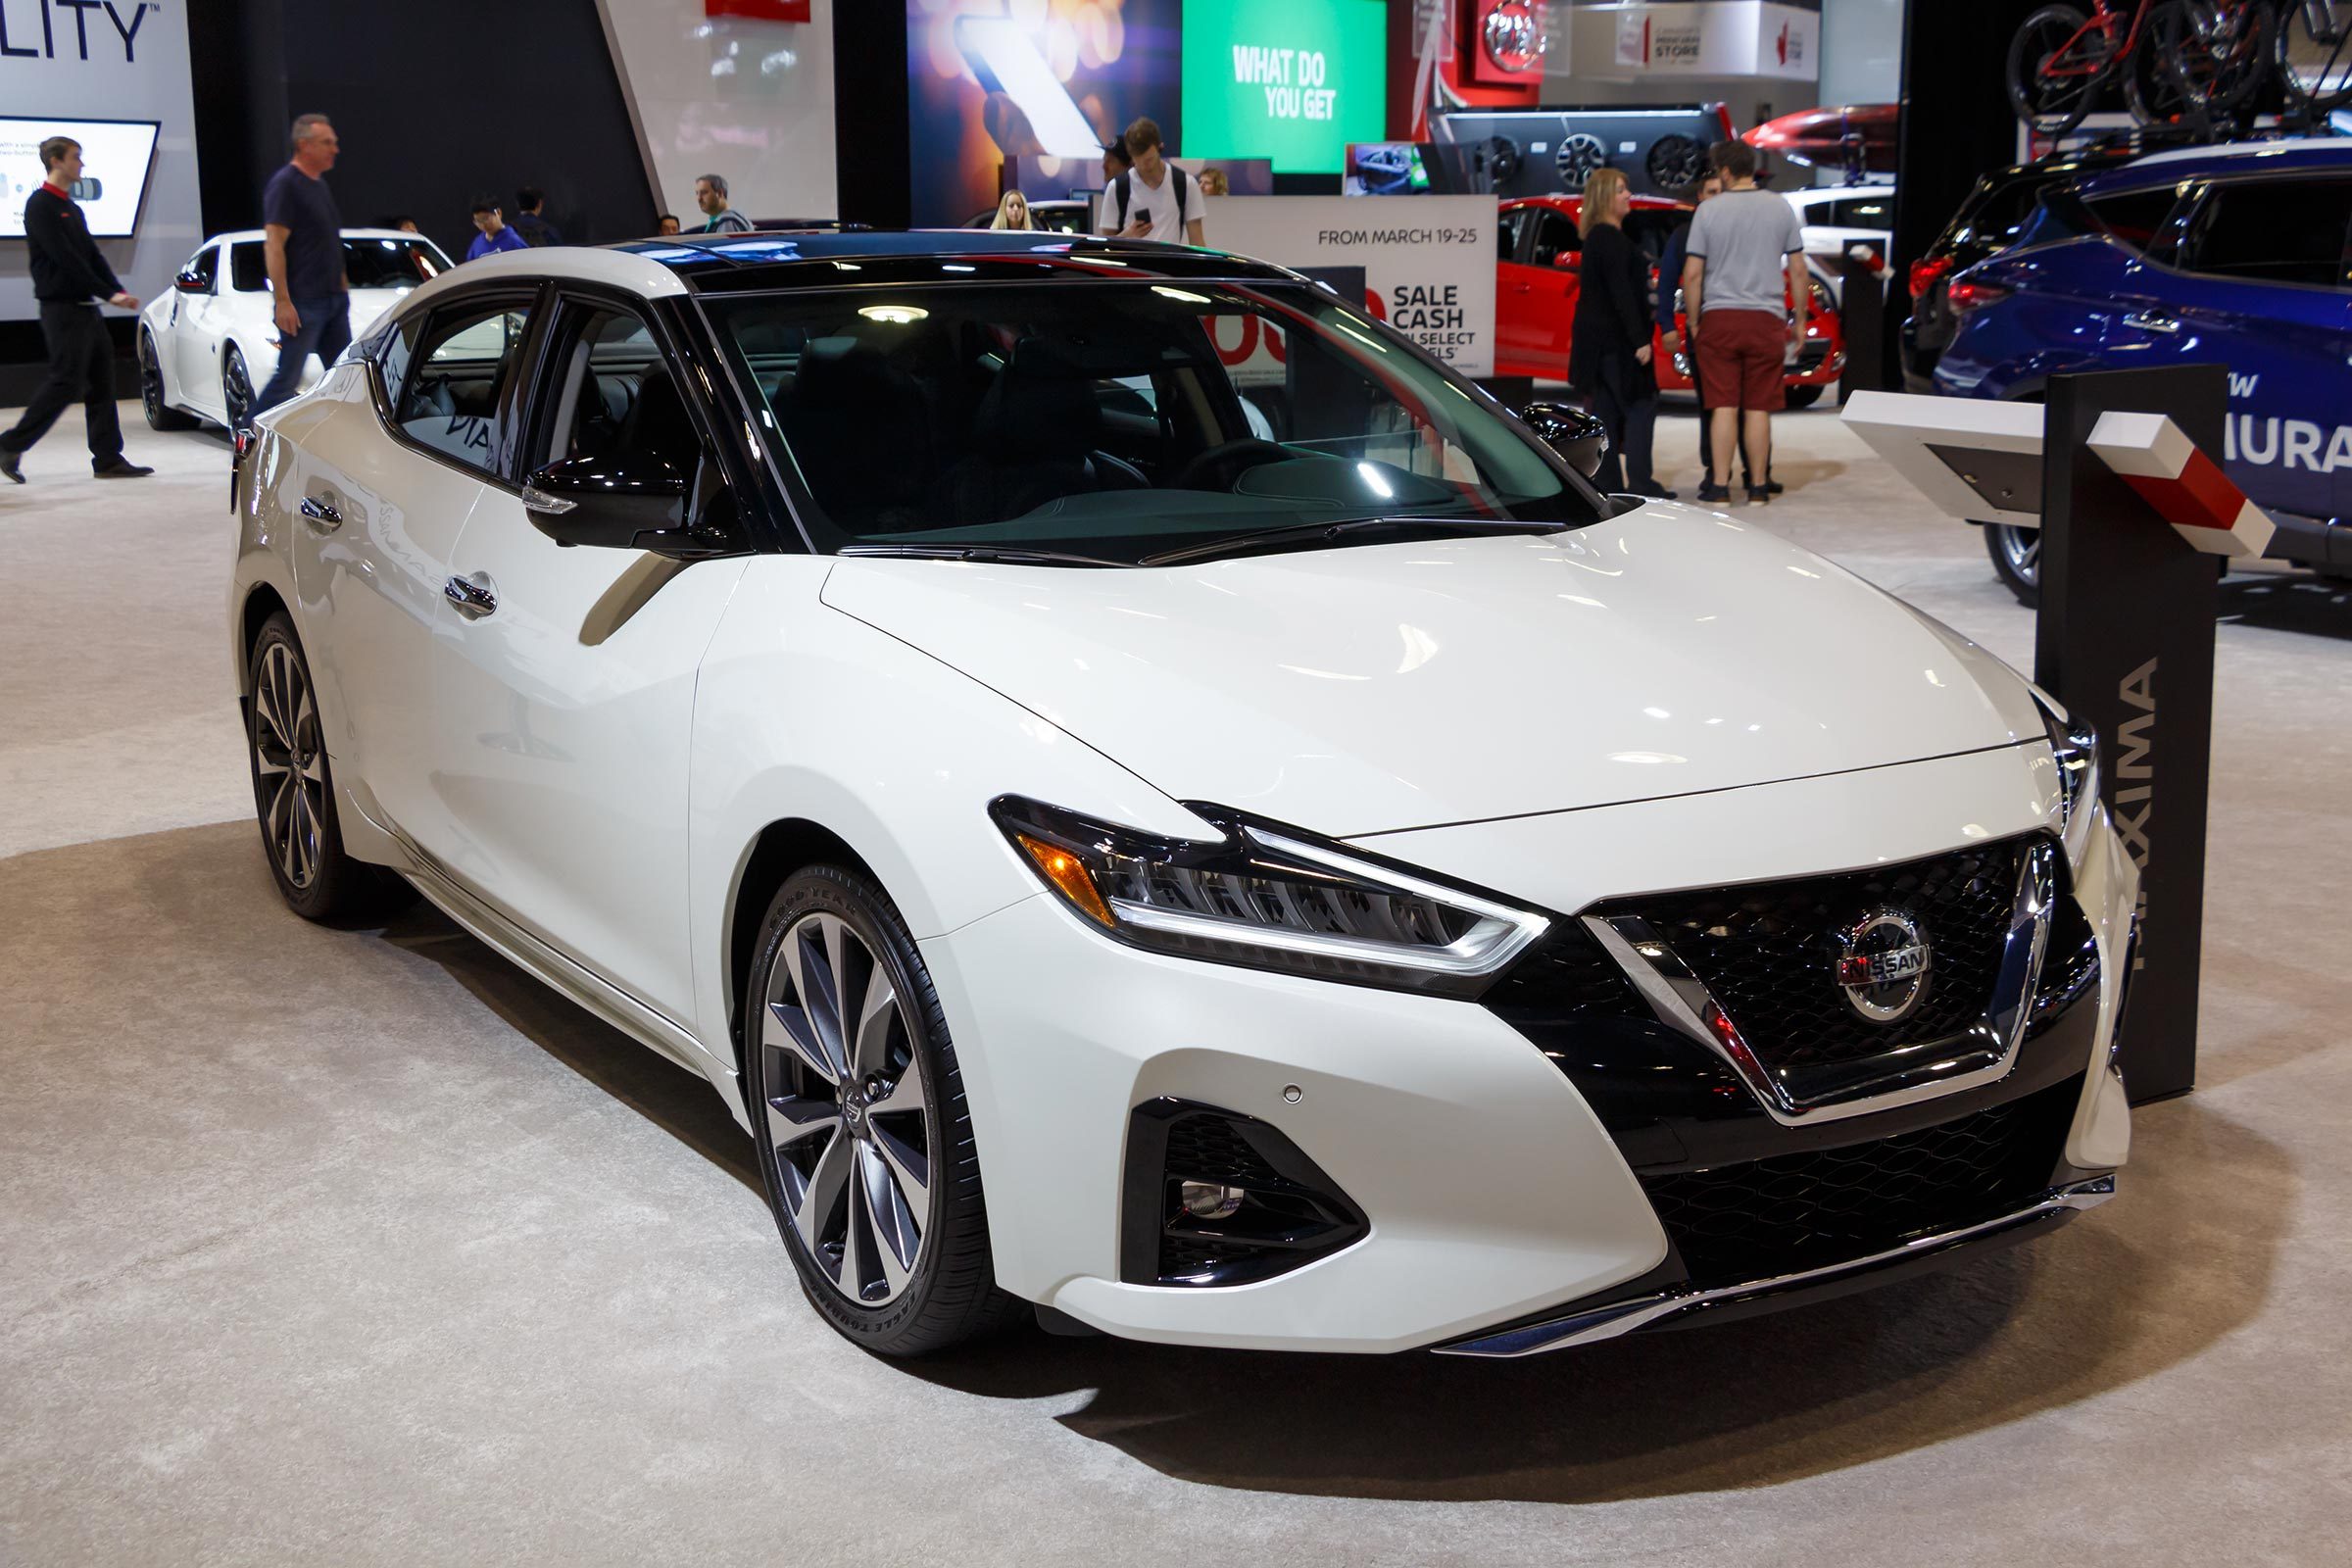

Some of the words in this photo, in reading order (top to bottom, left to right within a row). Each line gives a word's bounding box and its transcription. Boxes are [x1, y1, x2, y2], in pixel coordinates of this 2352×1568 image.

[1232, 45, 1295, 84] WHAT
[1298, 50, 1326, 87] DO
[1264, 85, 1300, 119] YOU
[1302, 88, 1337, 121] GET
[1318, 230, 1368, 245] FROM
[1372, 229, 1433, 244] MARCH
[1437, 228, 1478, 243] 19-25
[1393, 285, 1458, 307] SALE
[1392, 308, 1464, 329] CASH
[1419, 331, 1477, 345] SELECT
[1847, 951, 1923, 981] NISSAN
